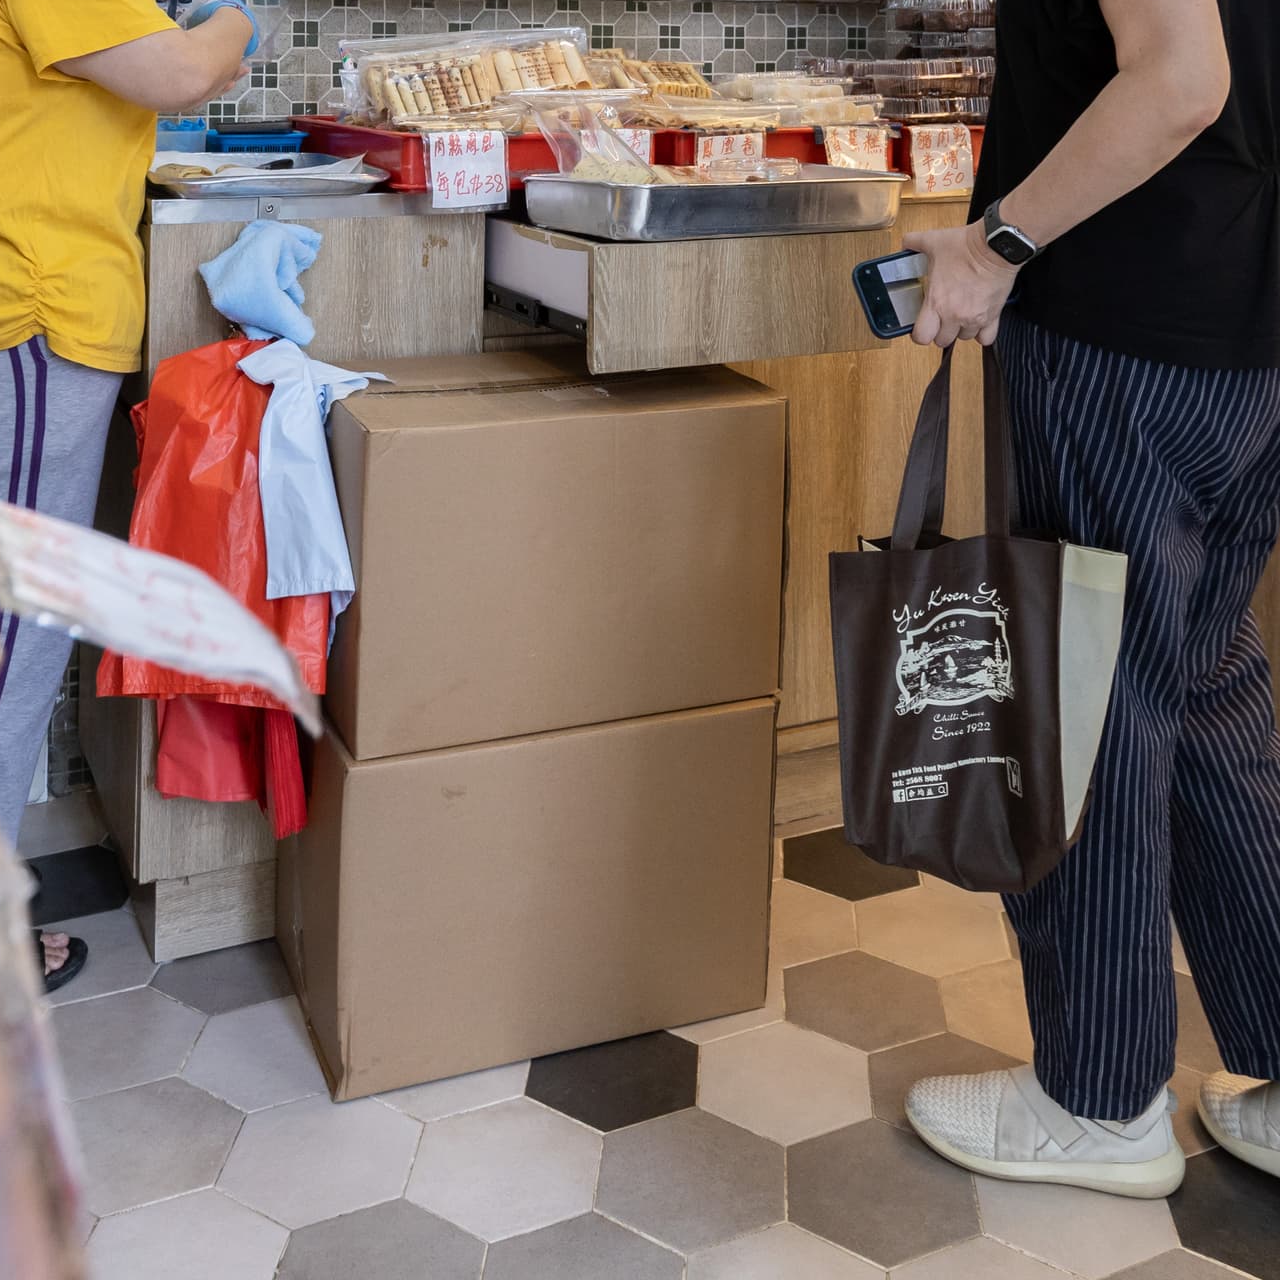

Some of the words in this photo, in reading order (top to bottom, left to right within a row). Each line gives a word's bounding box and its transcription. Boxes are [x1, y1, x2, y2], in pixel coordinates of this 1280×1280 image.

[892, 604, 925, 633] Yu
[932, 726, 964, 740] Since
[966, 721, 991, 734] 1922
